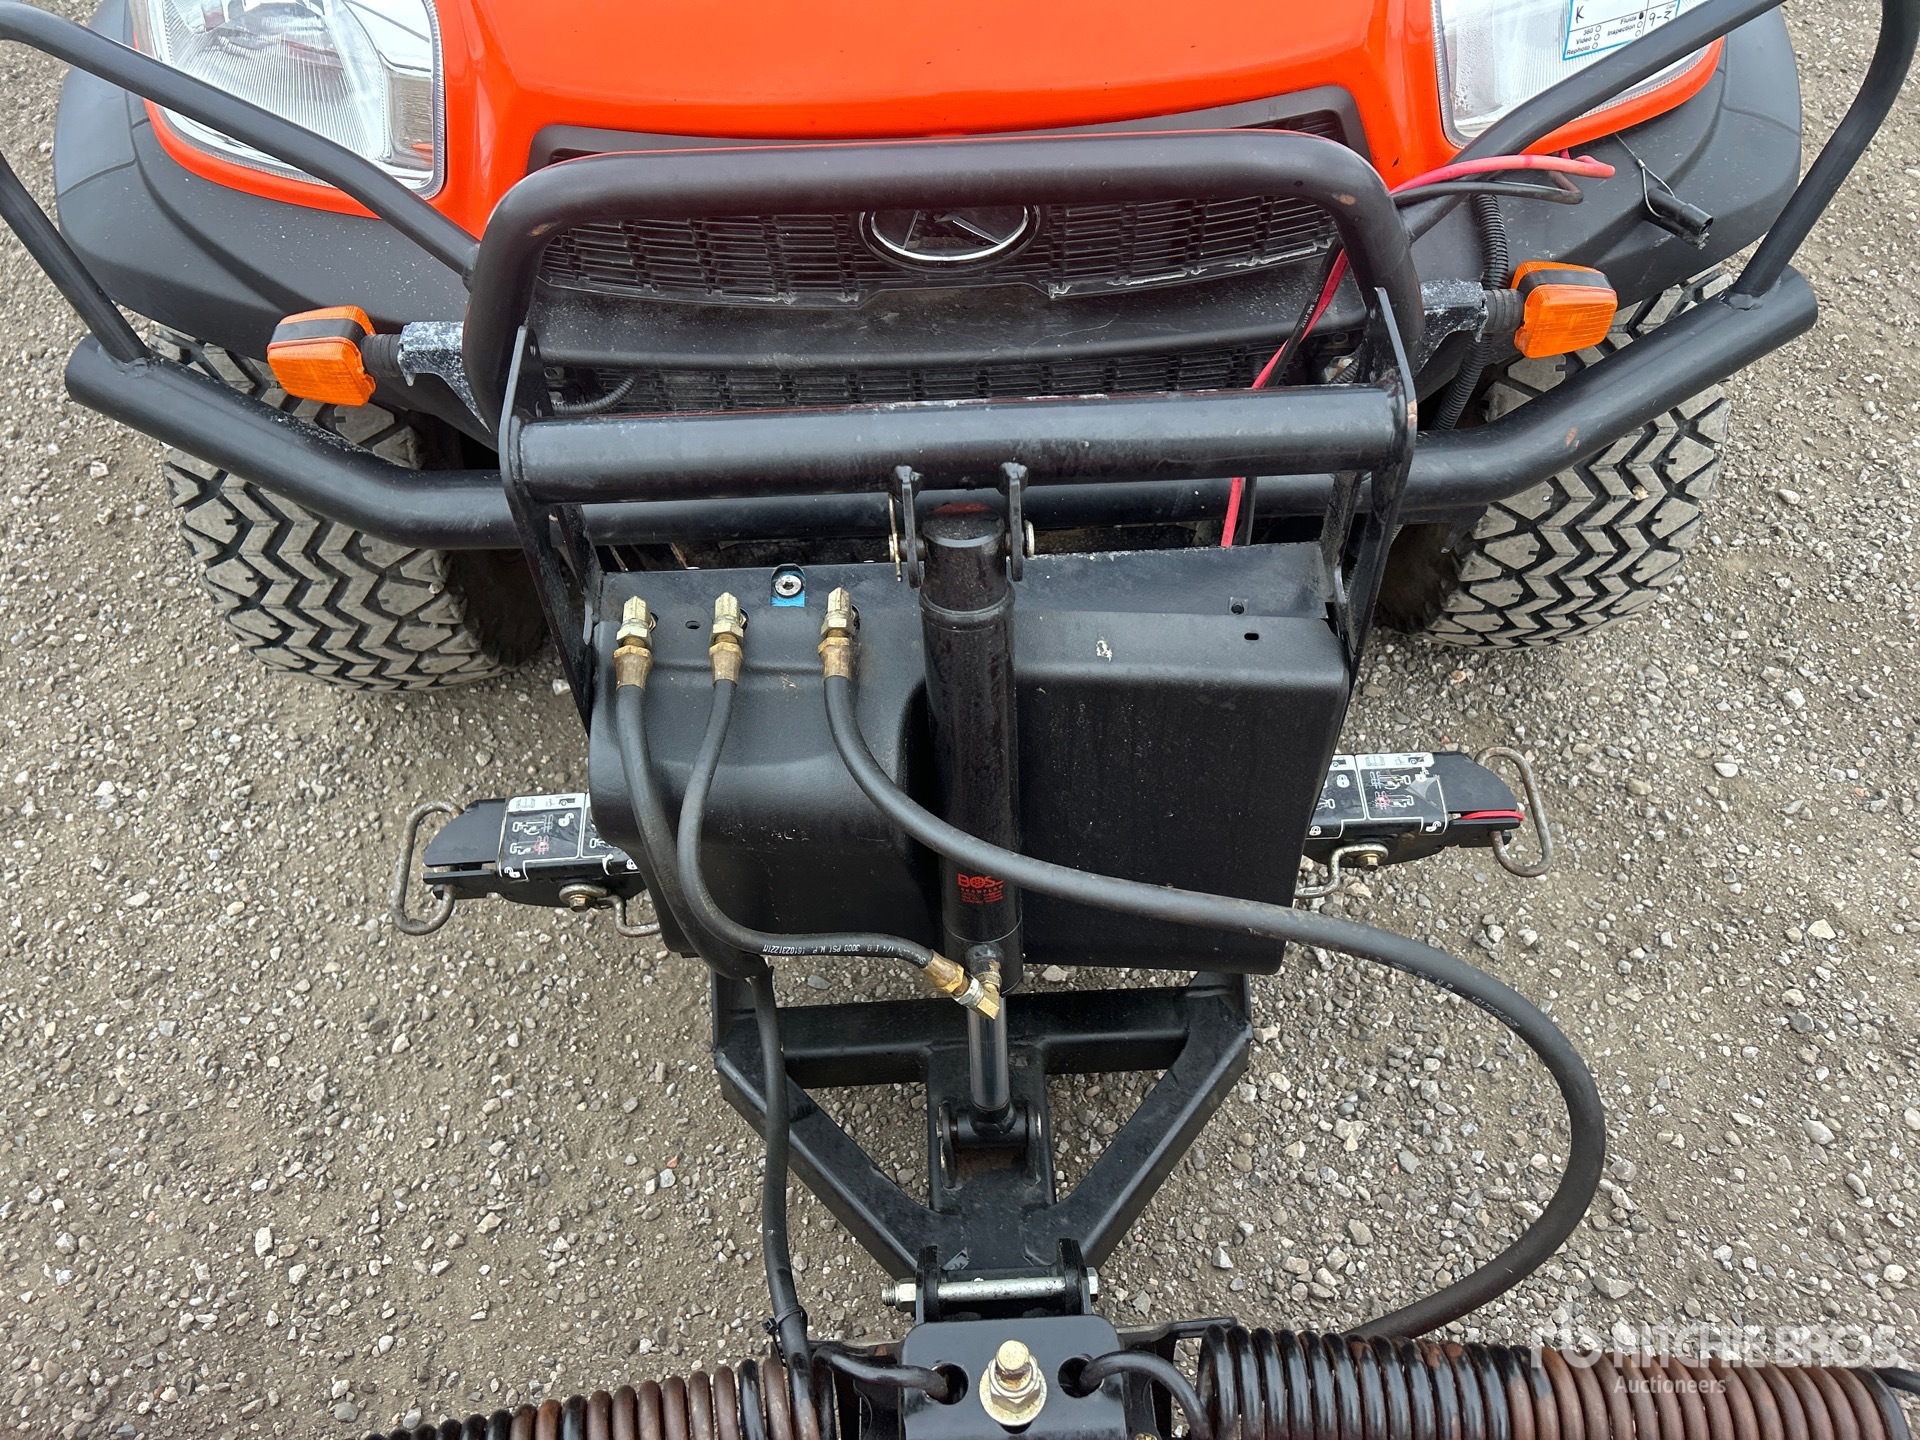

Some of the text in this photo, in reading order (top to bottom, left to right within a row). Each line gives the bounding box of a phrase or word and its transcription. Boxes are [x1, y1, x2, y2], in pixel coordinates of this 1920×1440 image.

[1620, 14, 1637, 25] Fluids
[1583, 27, 1594, 36] 360
[1607, 23, 1636, 37] Inspection
[1575, 35, 1592, 45] Video
[1566, 45, 1591, 56] Rephoto
